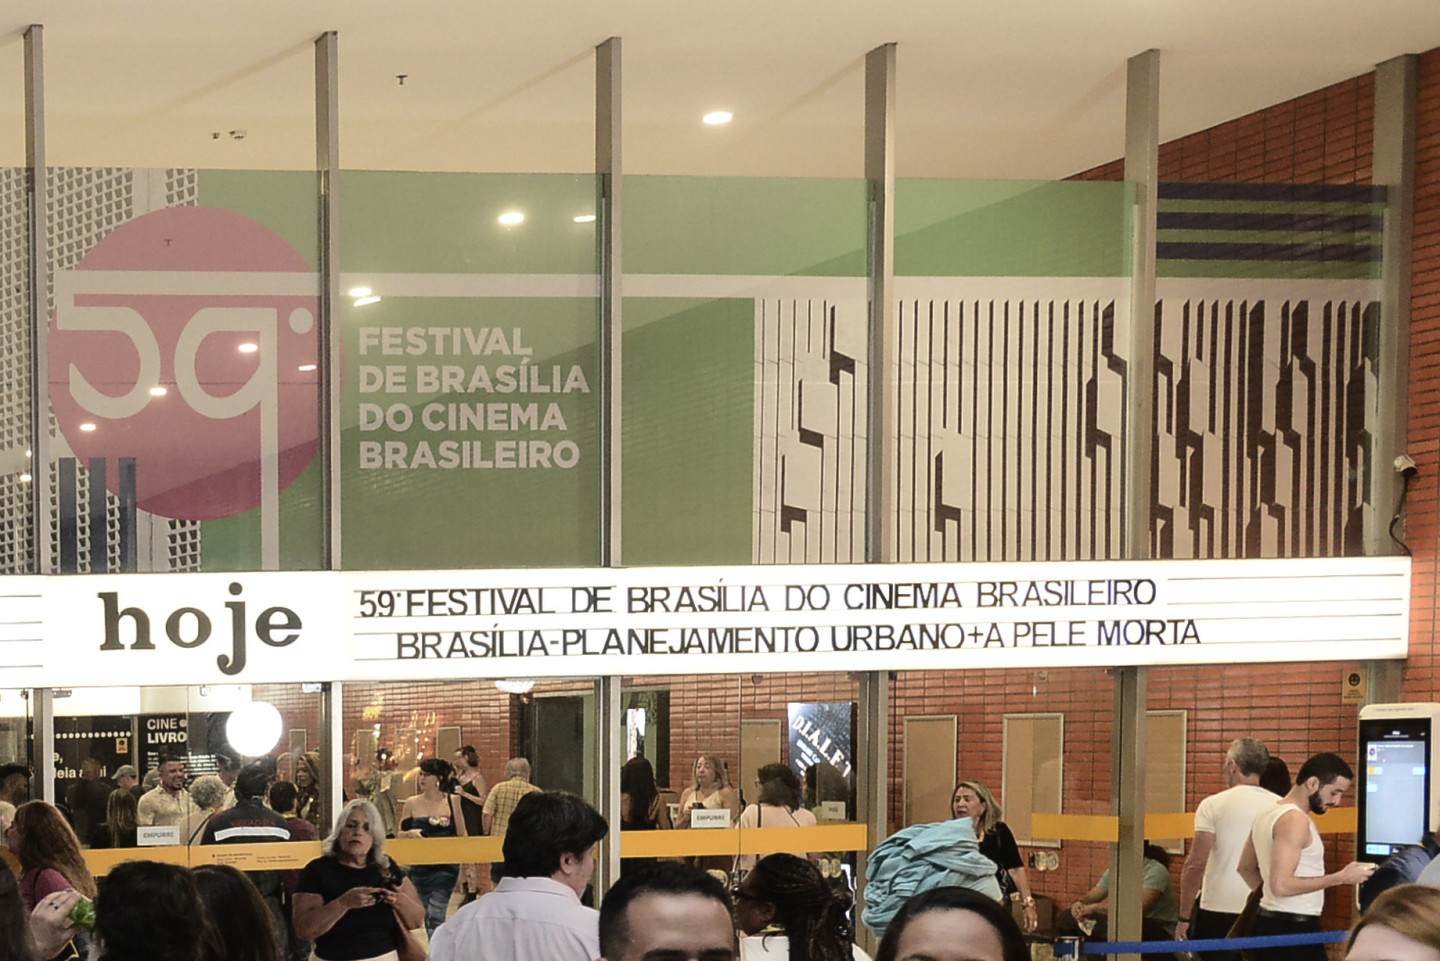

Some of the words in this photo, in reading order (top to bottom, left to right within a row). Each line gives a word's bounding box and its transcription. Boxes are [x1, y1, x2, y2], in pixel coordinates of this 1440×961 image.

[359, 326, 533, 356] FESTIVAL
[359, 365, 409, 393] DE
[417, 358, 590, 393] BRASÍLIA
[359, 403, 414, 432] DO
[421, 403, 567, 432] CINEMA
[359, 440, 581, 469] BRASILEIRO
[405, 587, 556, 617] FESTIVAL
[571, 586, 613, 614] DE
[627, 577, 770, 614] BRASÍLIA
[785, 584, 830, 611] DO
[844, 582, 962, 610] CINEMA
[976, 579, 1157, 608] BRASILEIRO
[98, 582, 303, 675] hoje
[1013, 620, 1086, 647] PELE
[1097, 618, 1201, 646] MORTA
[147, 718, 177, 730] CINE
[147, 732, 188, 744] LIVRO
